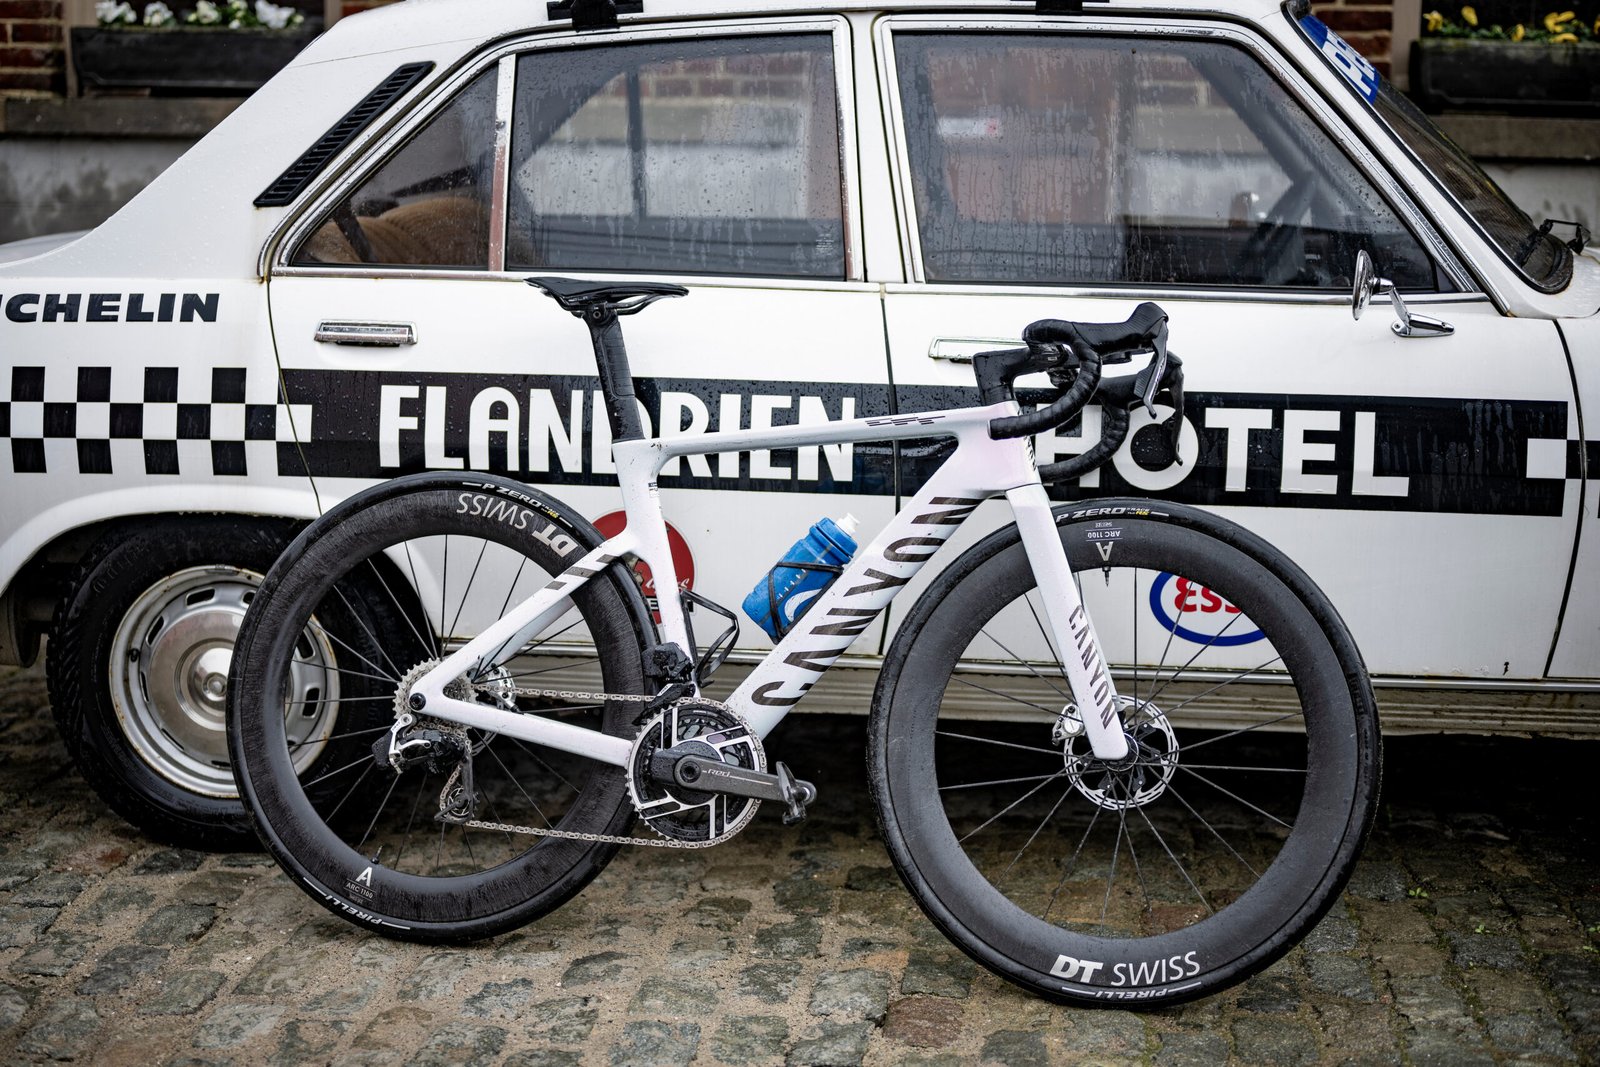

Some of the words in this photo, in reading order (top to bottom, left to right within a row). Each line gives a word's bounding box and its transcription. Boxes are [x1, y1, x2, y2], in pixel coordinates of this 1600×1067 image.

[0, 293, 219, 323] CHELIN
[1035, 402, 1410, 497] HOTEL
[456, 492, 535, 530] SWISS
[497, 486, 542, 508] ZERO
[1055, 512, 1070, 523] P
[1072, 507, 1126, 519] ZERO
[532, 523, 579, 558] DT
[1087, 531, 1103, 539] 1100
[1105, 530, 1121, 538] ARC
[751, 496, 985, 707] CANYON
[1068, 604, 1117, 730] CANYON
[325, 894, 383, 925] PIRELLI
[1050, 954, 1104, 983] DT
[1110, 950, 1201, 987] SWISS
[1095, 988, 1169, 999] PIRELLI
